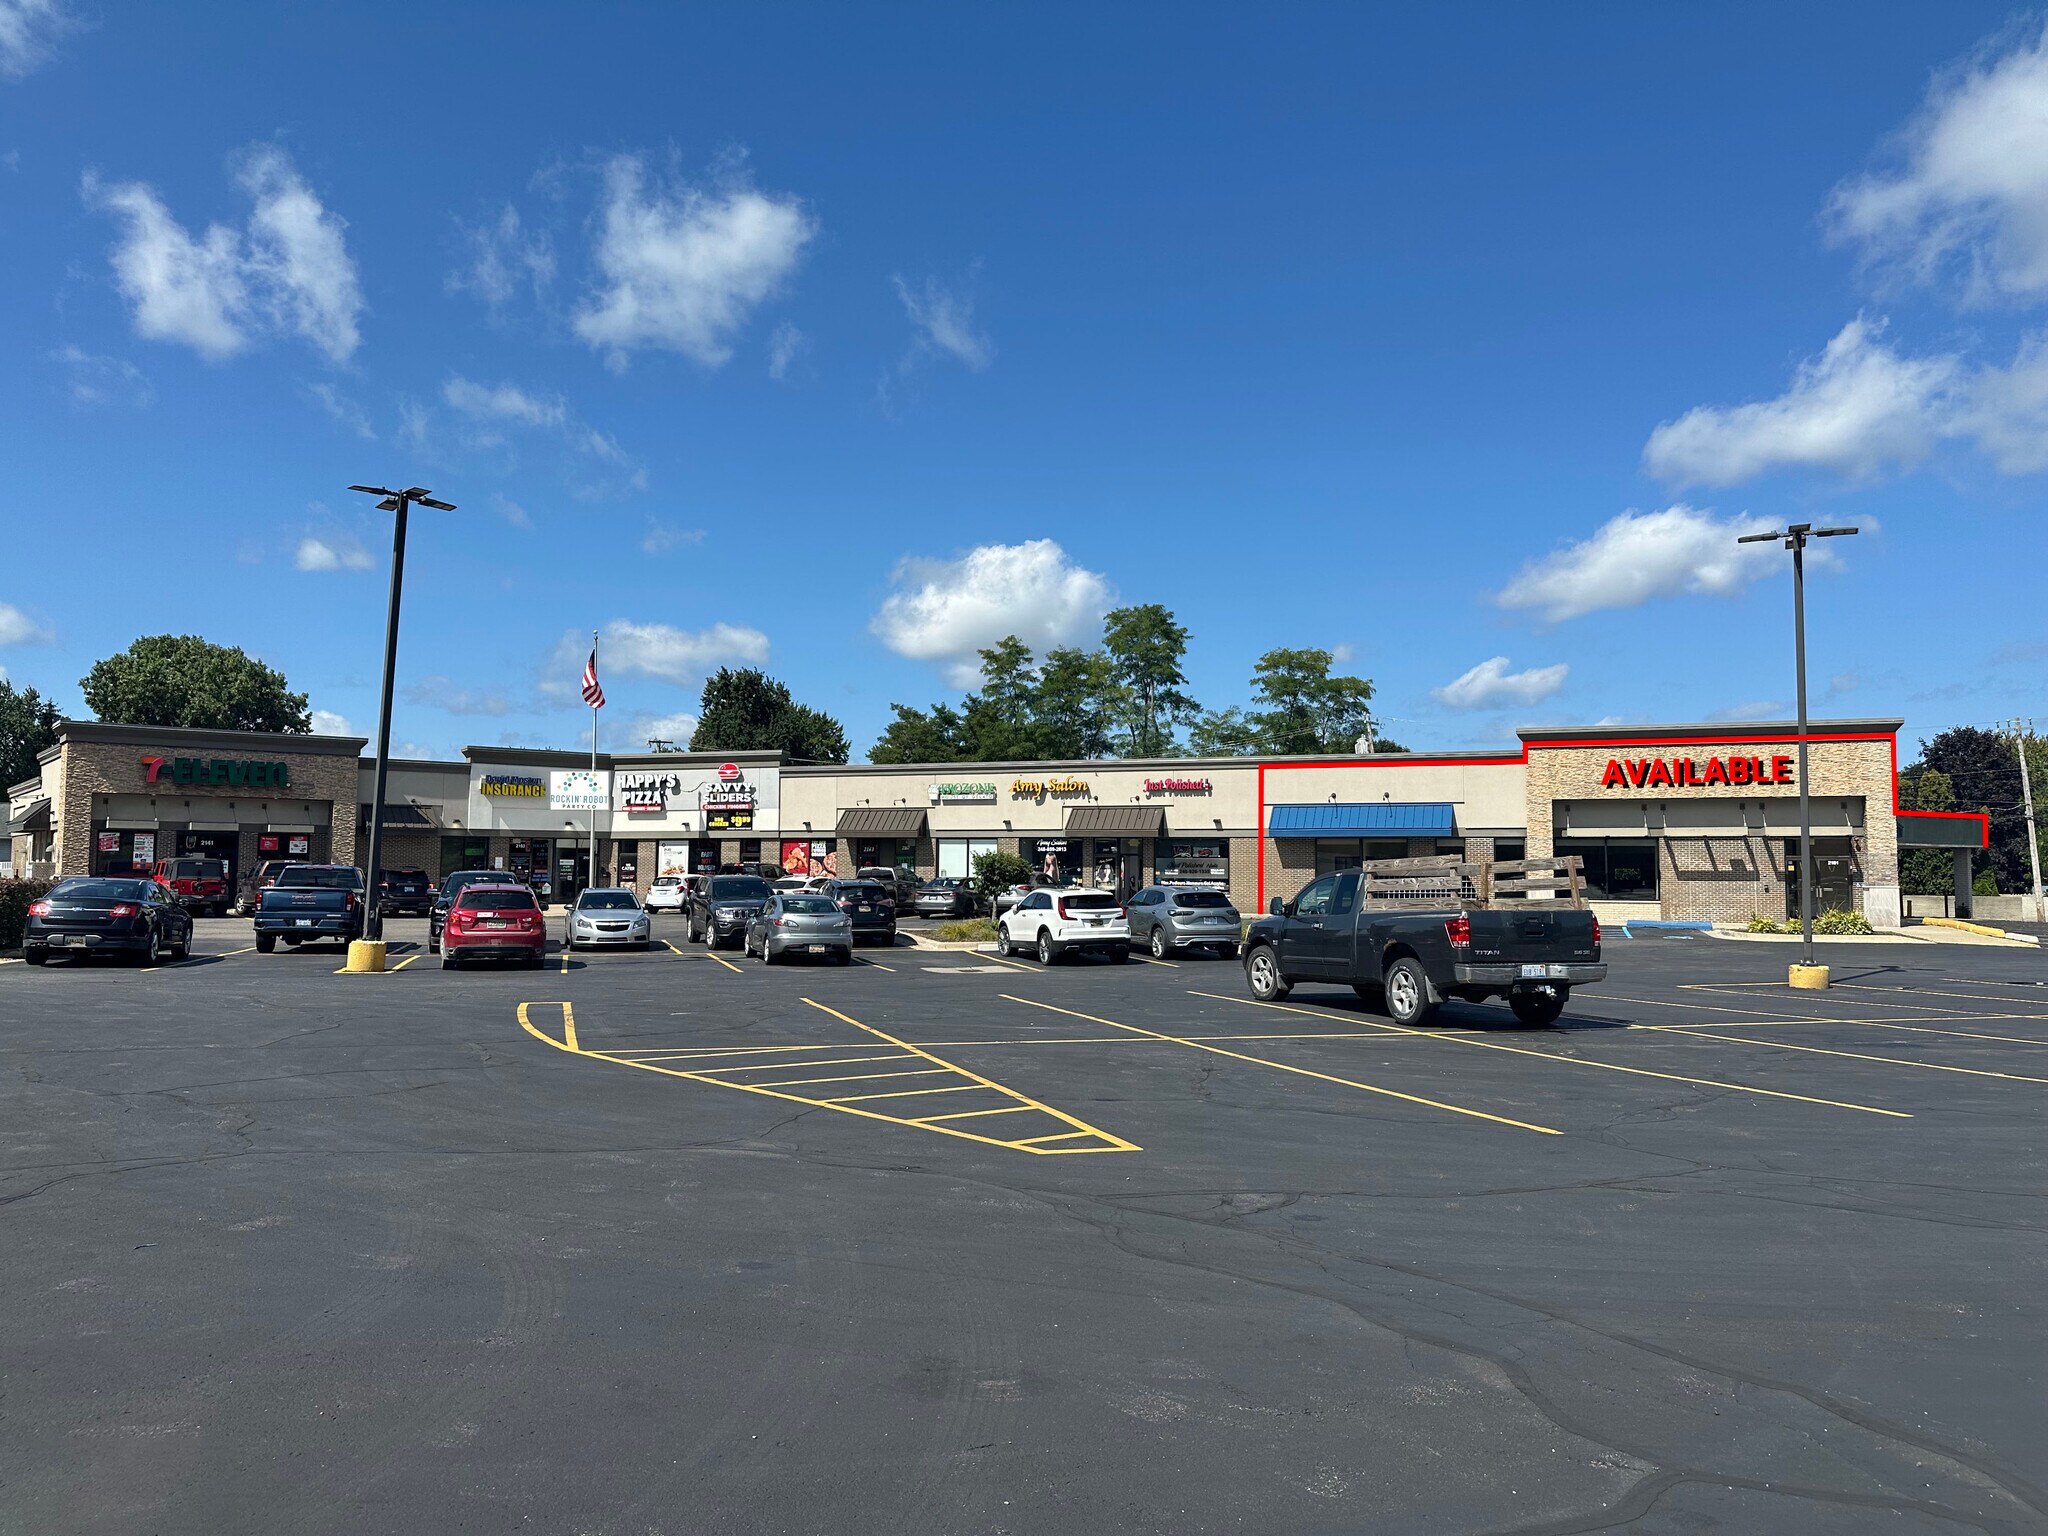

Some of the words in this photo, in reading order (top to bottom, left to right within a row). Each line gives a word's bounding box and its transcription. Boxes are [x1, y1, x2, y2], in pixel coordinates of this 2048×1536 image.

[615, 773, 677, 790] HAPPY'S
[705, 782, 752, 793] SAVVY
[1009, 778, 1042, 799] Amy
[1048, 776, 1088, 792] Salon
[1143, 779, 1164, 792] Just
[1165, 778, 1204, 790] Polished
[480, 783, 546, 797] INSURANCE
[622, 790, 661, 804] PIZZA
[703, 793, 752, 803] SLIDERS
